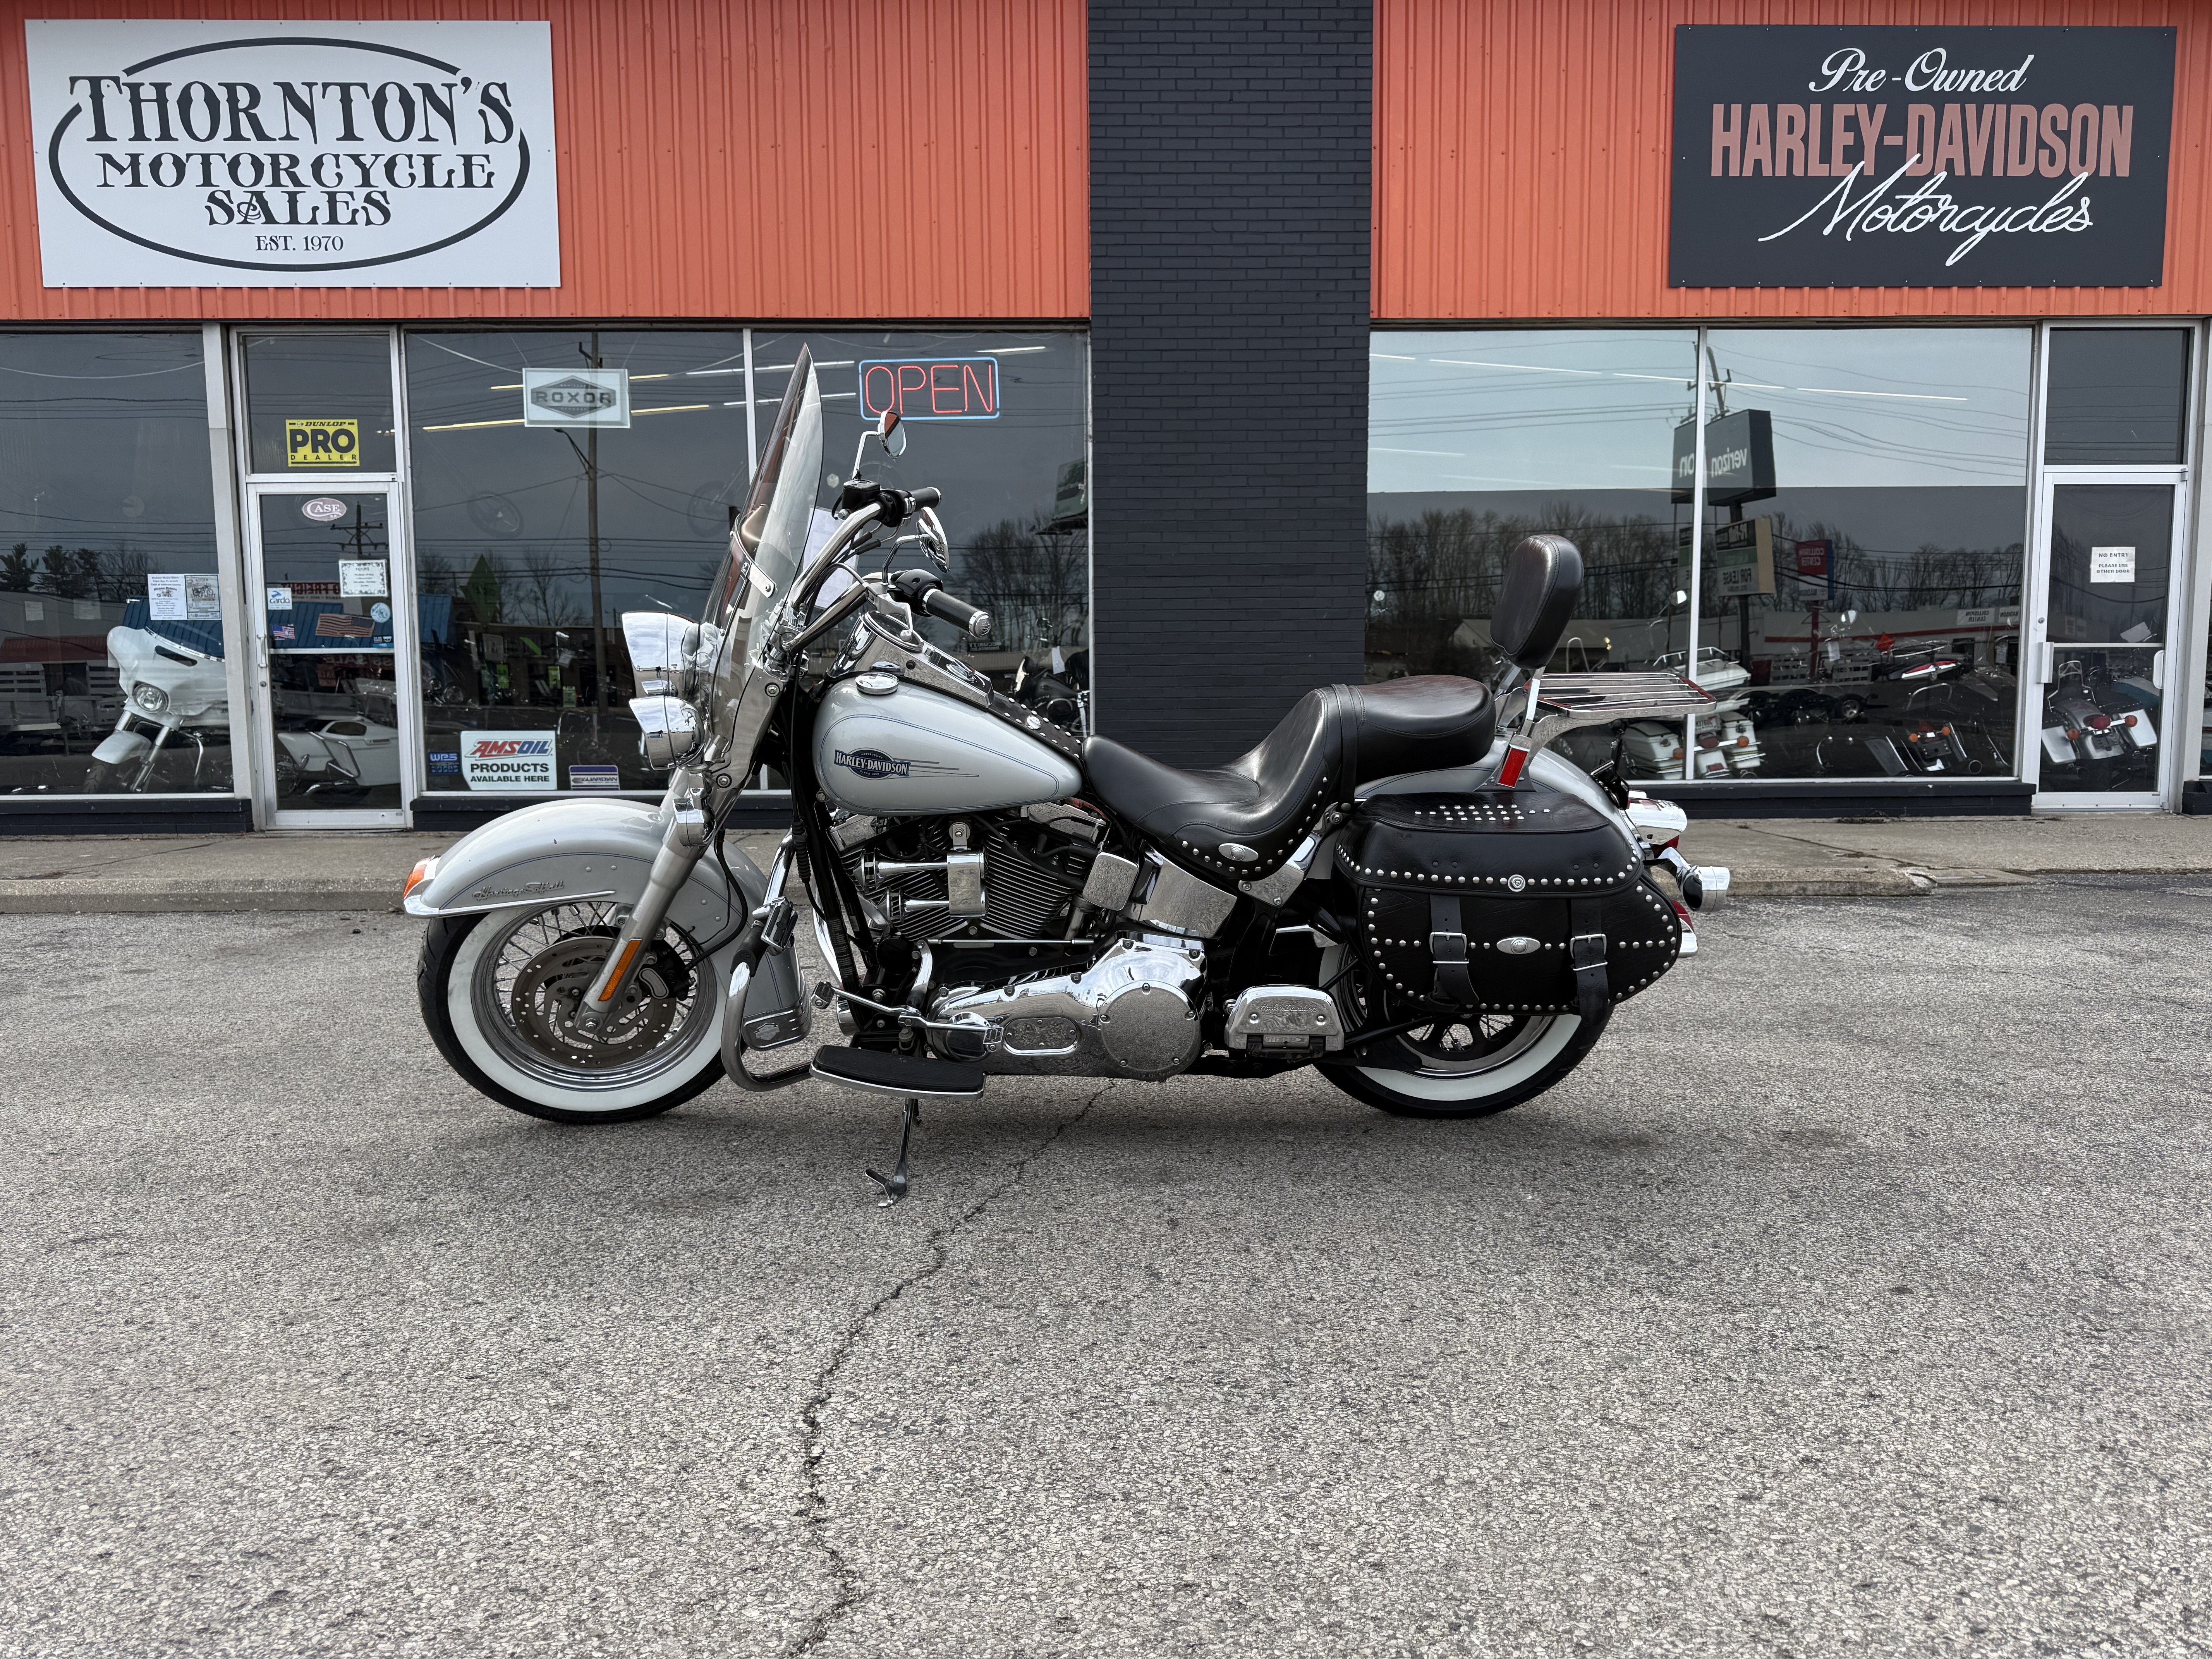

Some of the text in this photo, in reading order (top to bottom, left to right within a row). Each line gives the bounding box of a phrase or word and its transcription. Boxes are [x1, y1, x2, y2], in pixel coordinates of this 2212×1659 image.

[1808, 47, 2035, 93] Pre-Owned
[69, 76, 514, 146] THORNTON'S
[1711, 103, 2134, 177] HARLEY-DAVIDSON
[95, 153, 495, 189] MOTORCYCLE
[205, 190, 391, 226] SALES
[1758, 153, 2093, 266] Motorcycles
[255, 235, 344, 252] EST. 1970
[535, 392, 611, 404] ROXOR
[866, 365, 993, 414] OPEN
[289, 428, 356, 453] PRO
[429, 753, 457, 761] WPS
[471, 740, 551, 757] AMSOIL
[471, 763, 549, 773] PRODUCTS
[472, 885, 524, 902] Heritage
